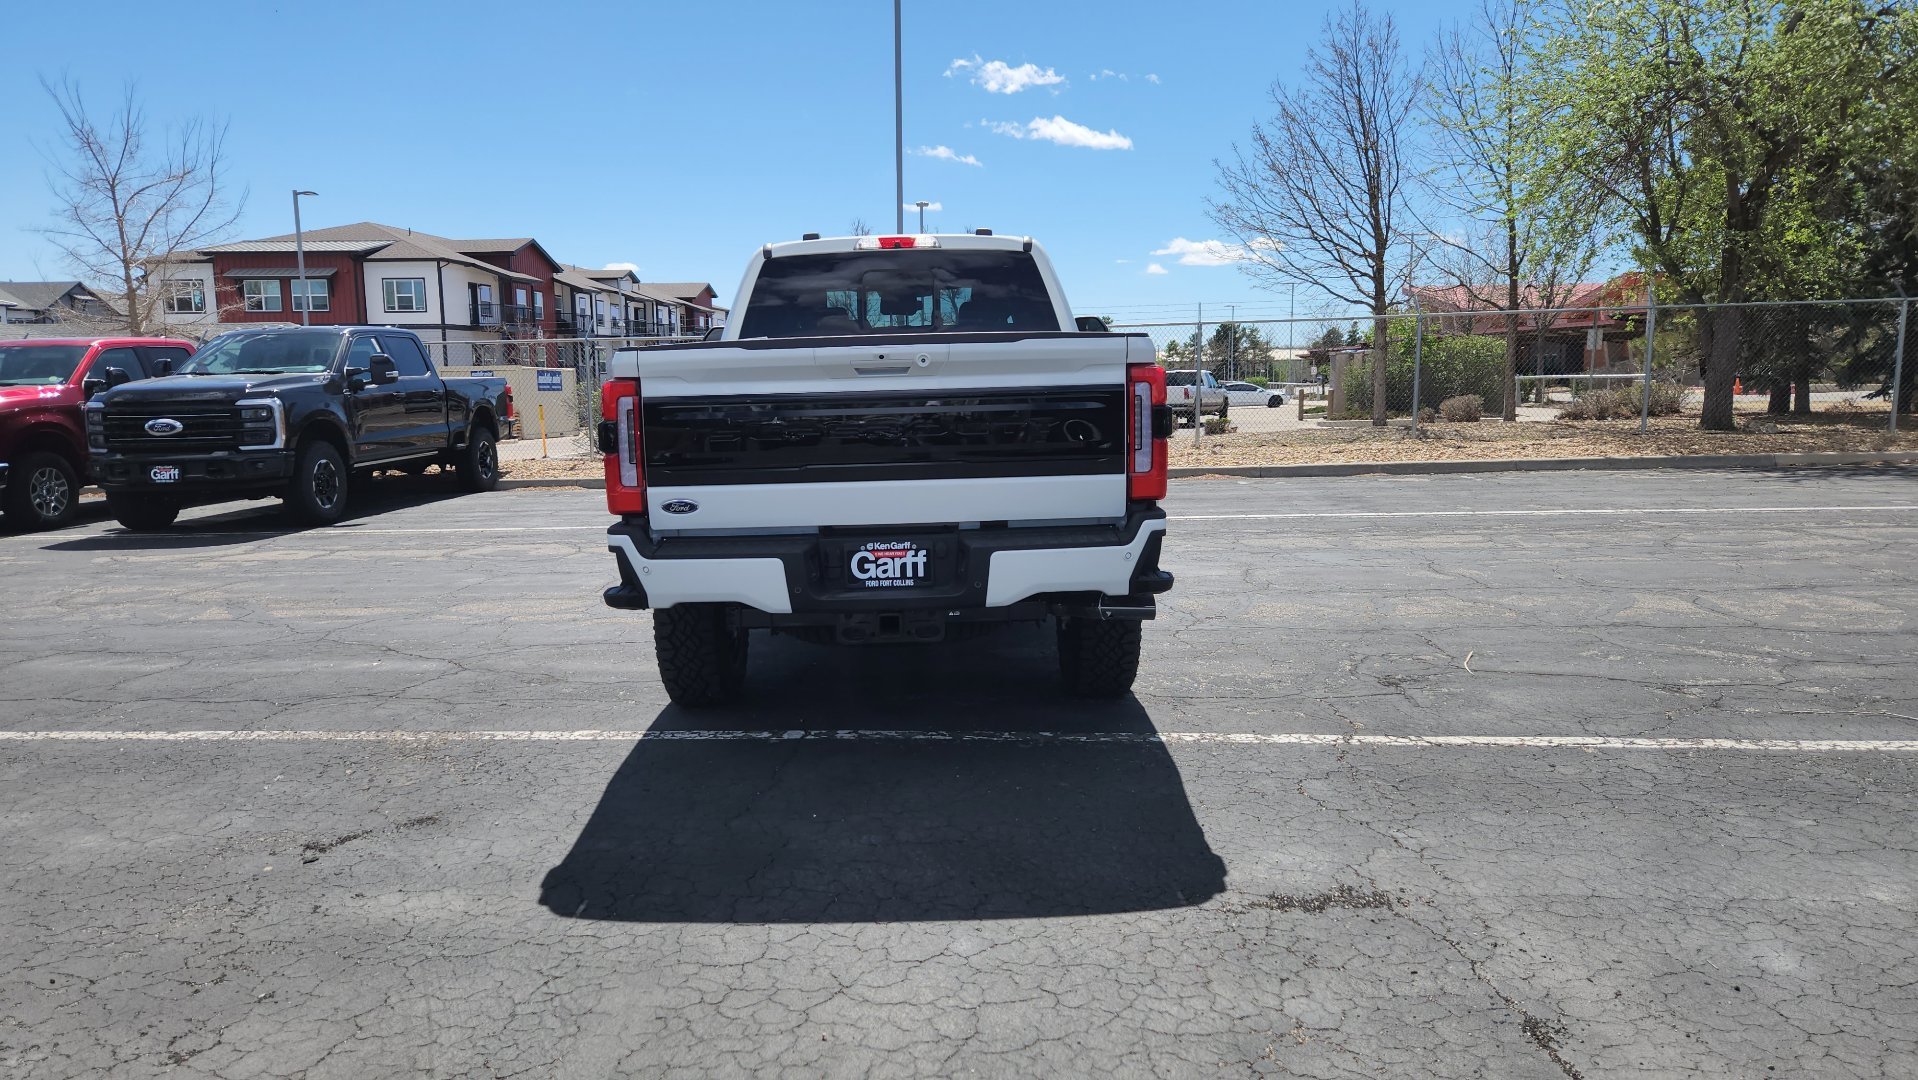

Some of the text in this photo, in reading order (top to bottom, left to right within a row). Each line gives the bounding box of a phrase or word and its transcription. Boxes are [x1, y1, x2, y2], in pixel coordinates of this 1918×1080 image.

[151, 468, 179, 480] Garff
[670, 502, 690, 511] Ford
[874, 541, 911, 550] Ken Garff
[851, 550, 927, 579] Garff
